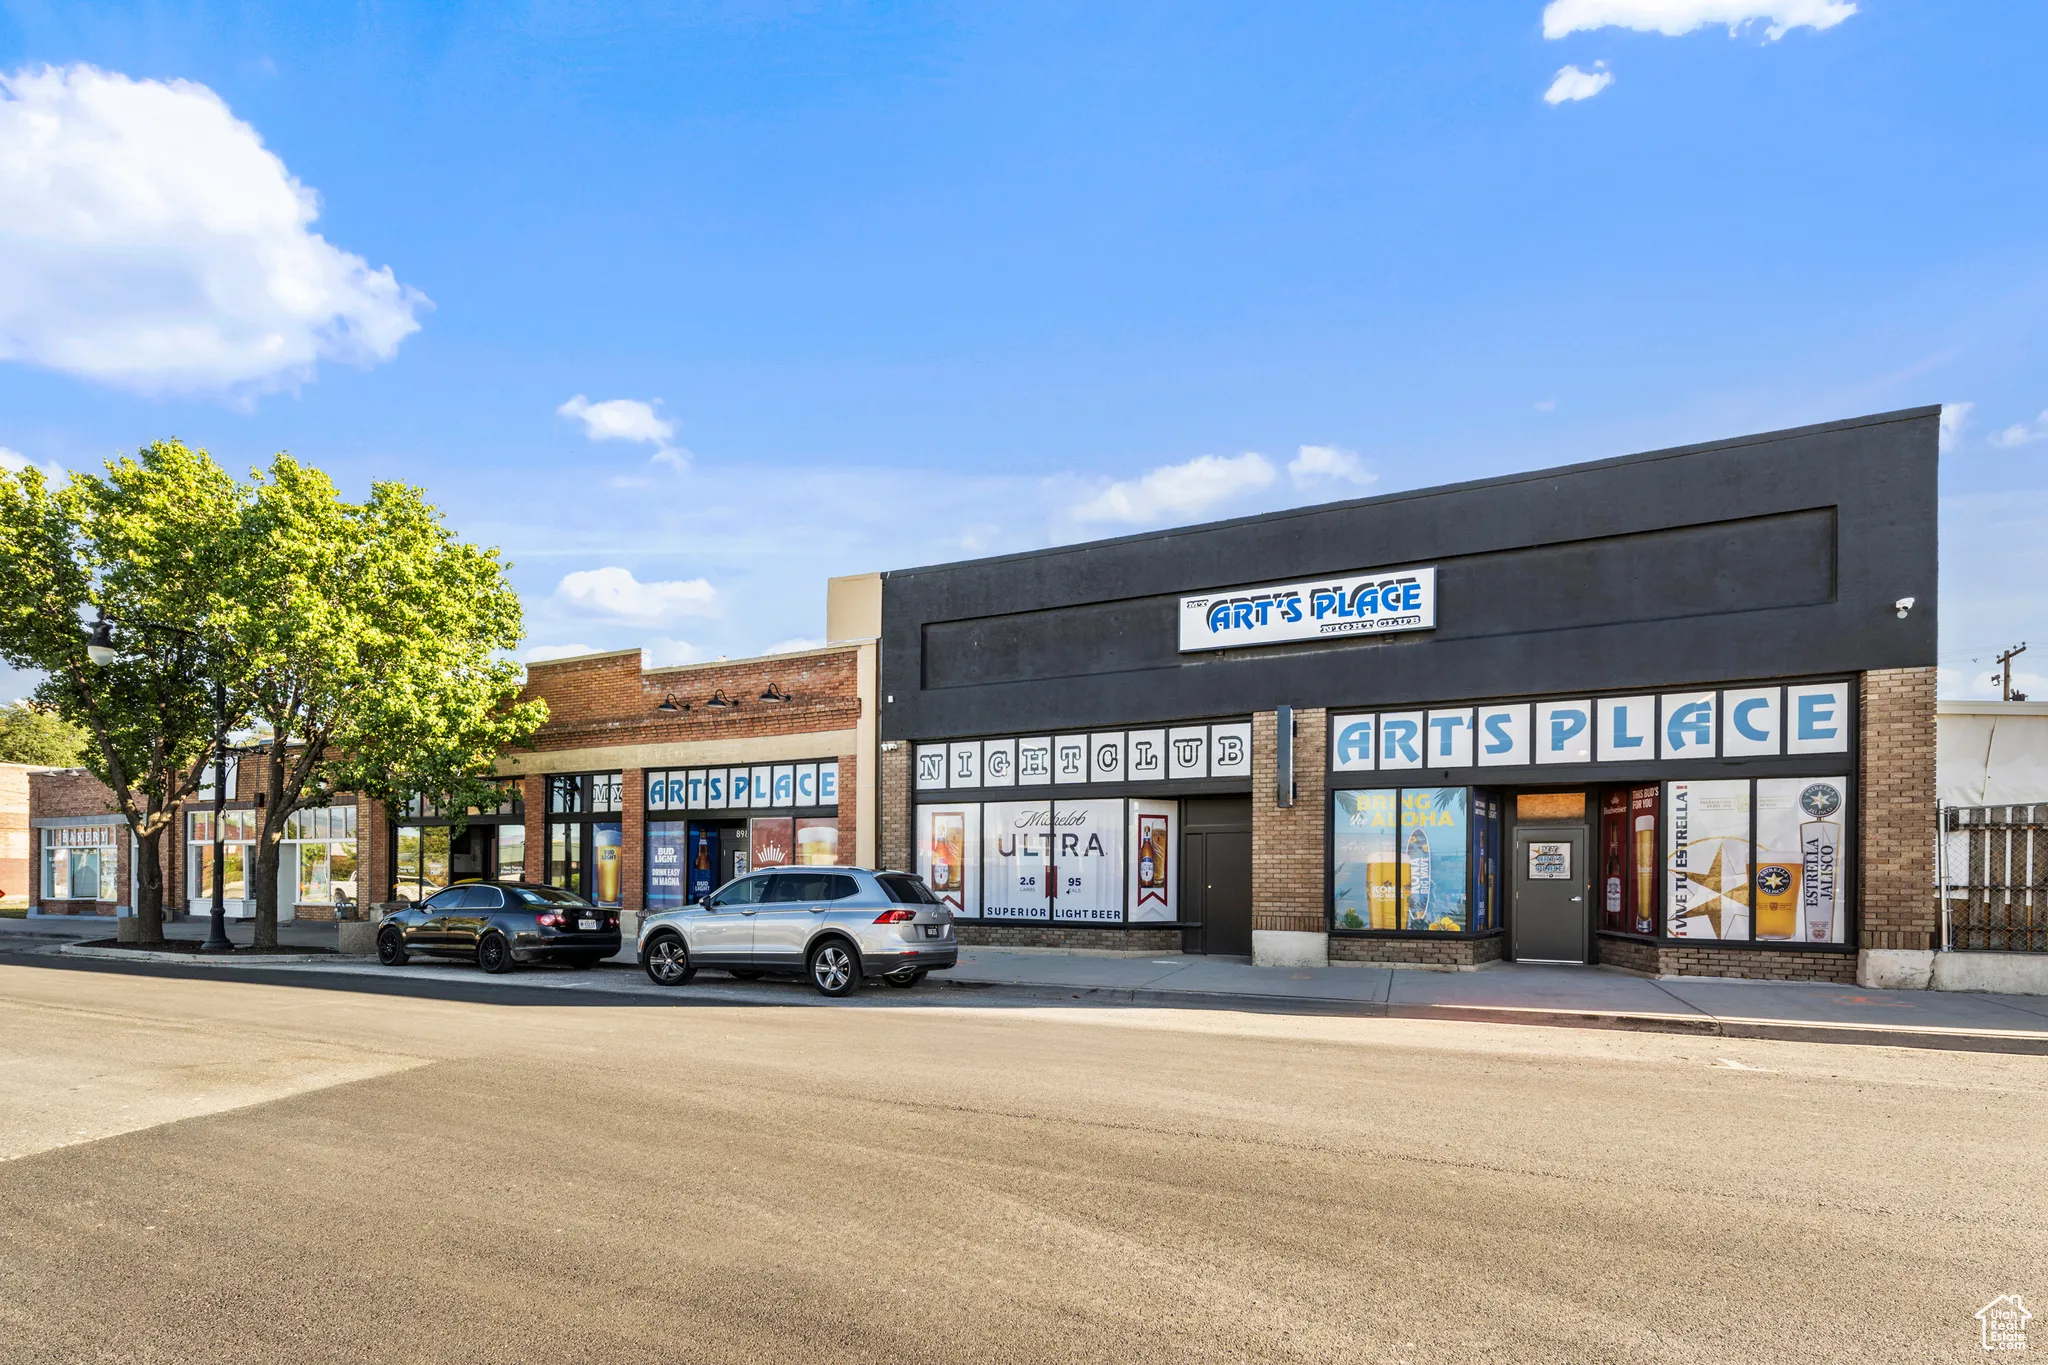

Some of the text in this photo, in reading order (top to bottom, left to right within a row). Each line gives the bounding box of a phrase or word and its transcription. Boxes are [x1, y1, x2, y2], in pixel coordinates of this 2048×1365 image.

[1207, 579, 1422, 633] ART'S PLACE
[1320, 615, 1421, 634] NIGHT CLUB
[1337, 693, 1838, 765] ART'S PLACE
[593, 783, 622, 803] MY
[650, 772, 836, 805] ART'S PLACE
[1632, 786, 1659, 800] THIS BUD'S
[1804, 785, 1836, 797] ESTRELLA
[1357, 793, 1431, 811] BRING
[1632, 798, 1653, 810] FOR YOU
[1603, 805, 1627, 815] Budweiser
[1807, 807, 1833, 815] JALISCO
[1015, 810, 1088, 828] Michelob
[1350, 810, 1455, 827] the ALOHA
[62, 831, 107, 843] BAKERY
[657, 847, 675, 855] BUD
[998, 833, 1105, 857] ULTRA
[654, 855, 678, 863] LIGHT
[667, 868, 680, 876] EASY
[1535, 863, 1565, 873] PLACE
[1760, 867, 1788, 877] ESTRELLA
[1806, 837, 1818, 907] ESTRELLA
[1820, 844, 1833, 900] JALISCO
[652, 877, 680, 886] IN MAGNA
[1020, 877, 1035, 886] 2.6
[1068, 877, 1082, 887] 95
[1420, 857, 1429, 894] BIG WAVE
[1676, 871, 1688, 891] TU
[987, 907, 1120, 919] SUPERIOR LIGHT BEER
